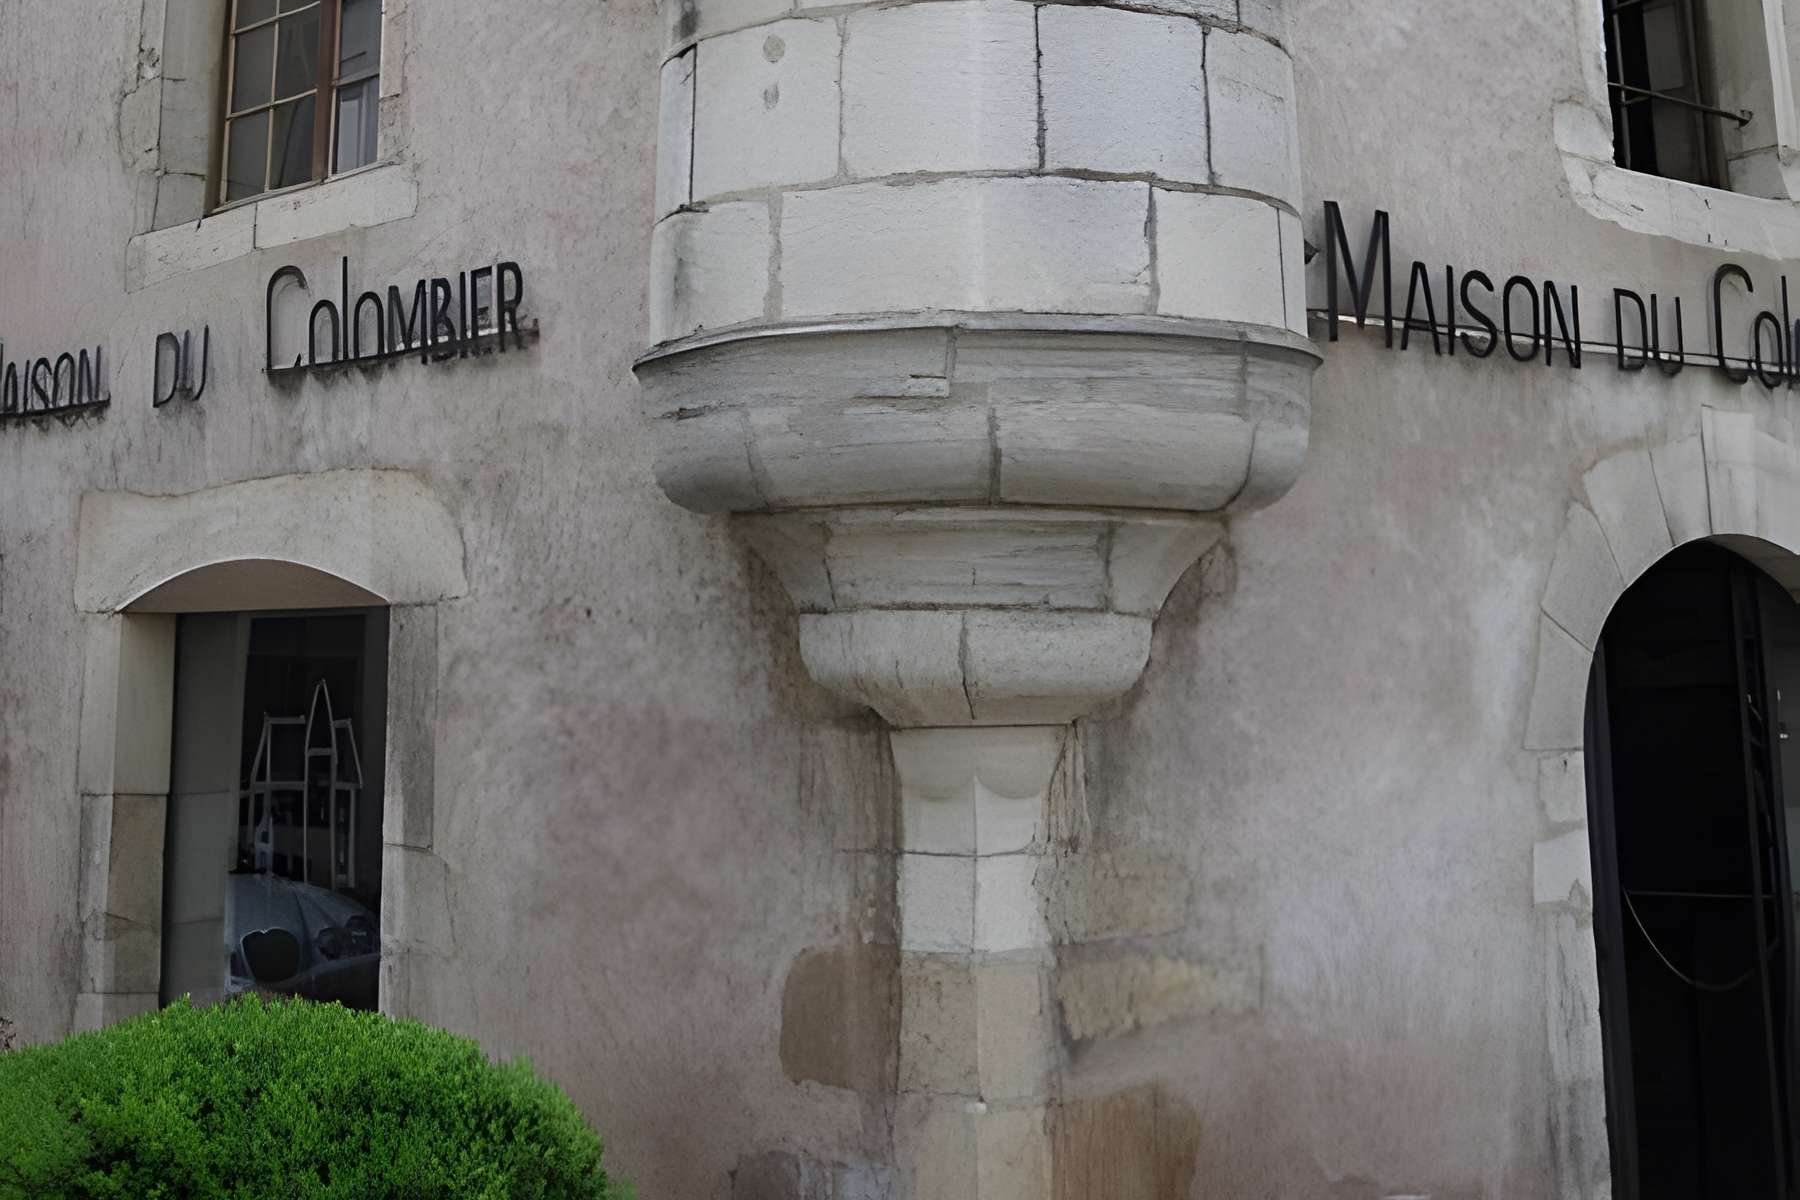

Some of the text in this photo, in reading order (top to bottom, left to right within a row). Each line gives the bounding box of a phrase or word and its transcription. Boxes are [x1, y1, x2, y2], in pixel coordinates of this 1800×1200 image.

[0, 343, 102, 415] AISON
[152, 324, 210, 408] DU
[1613, 287, 1685, 376] DU
